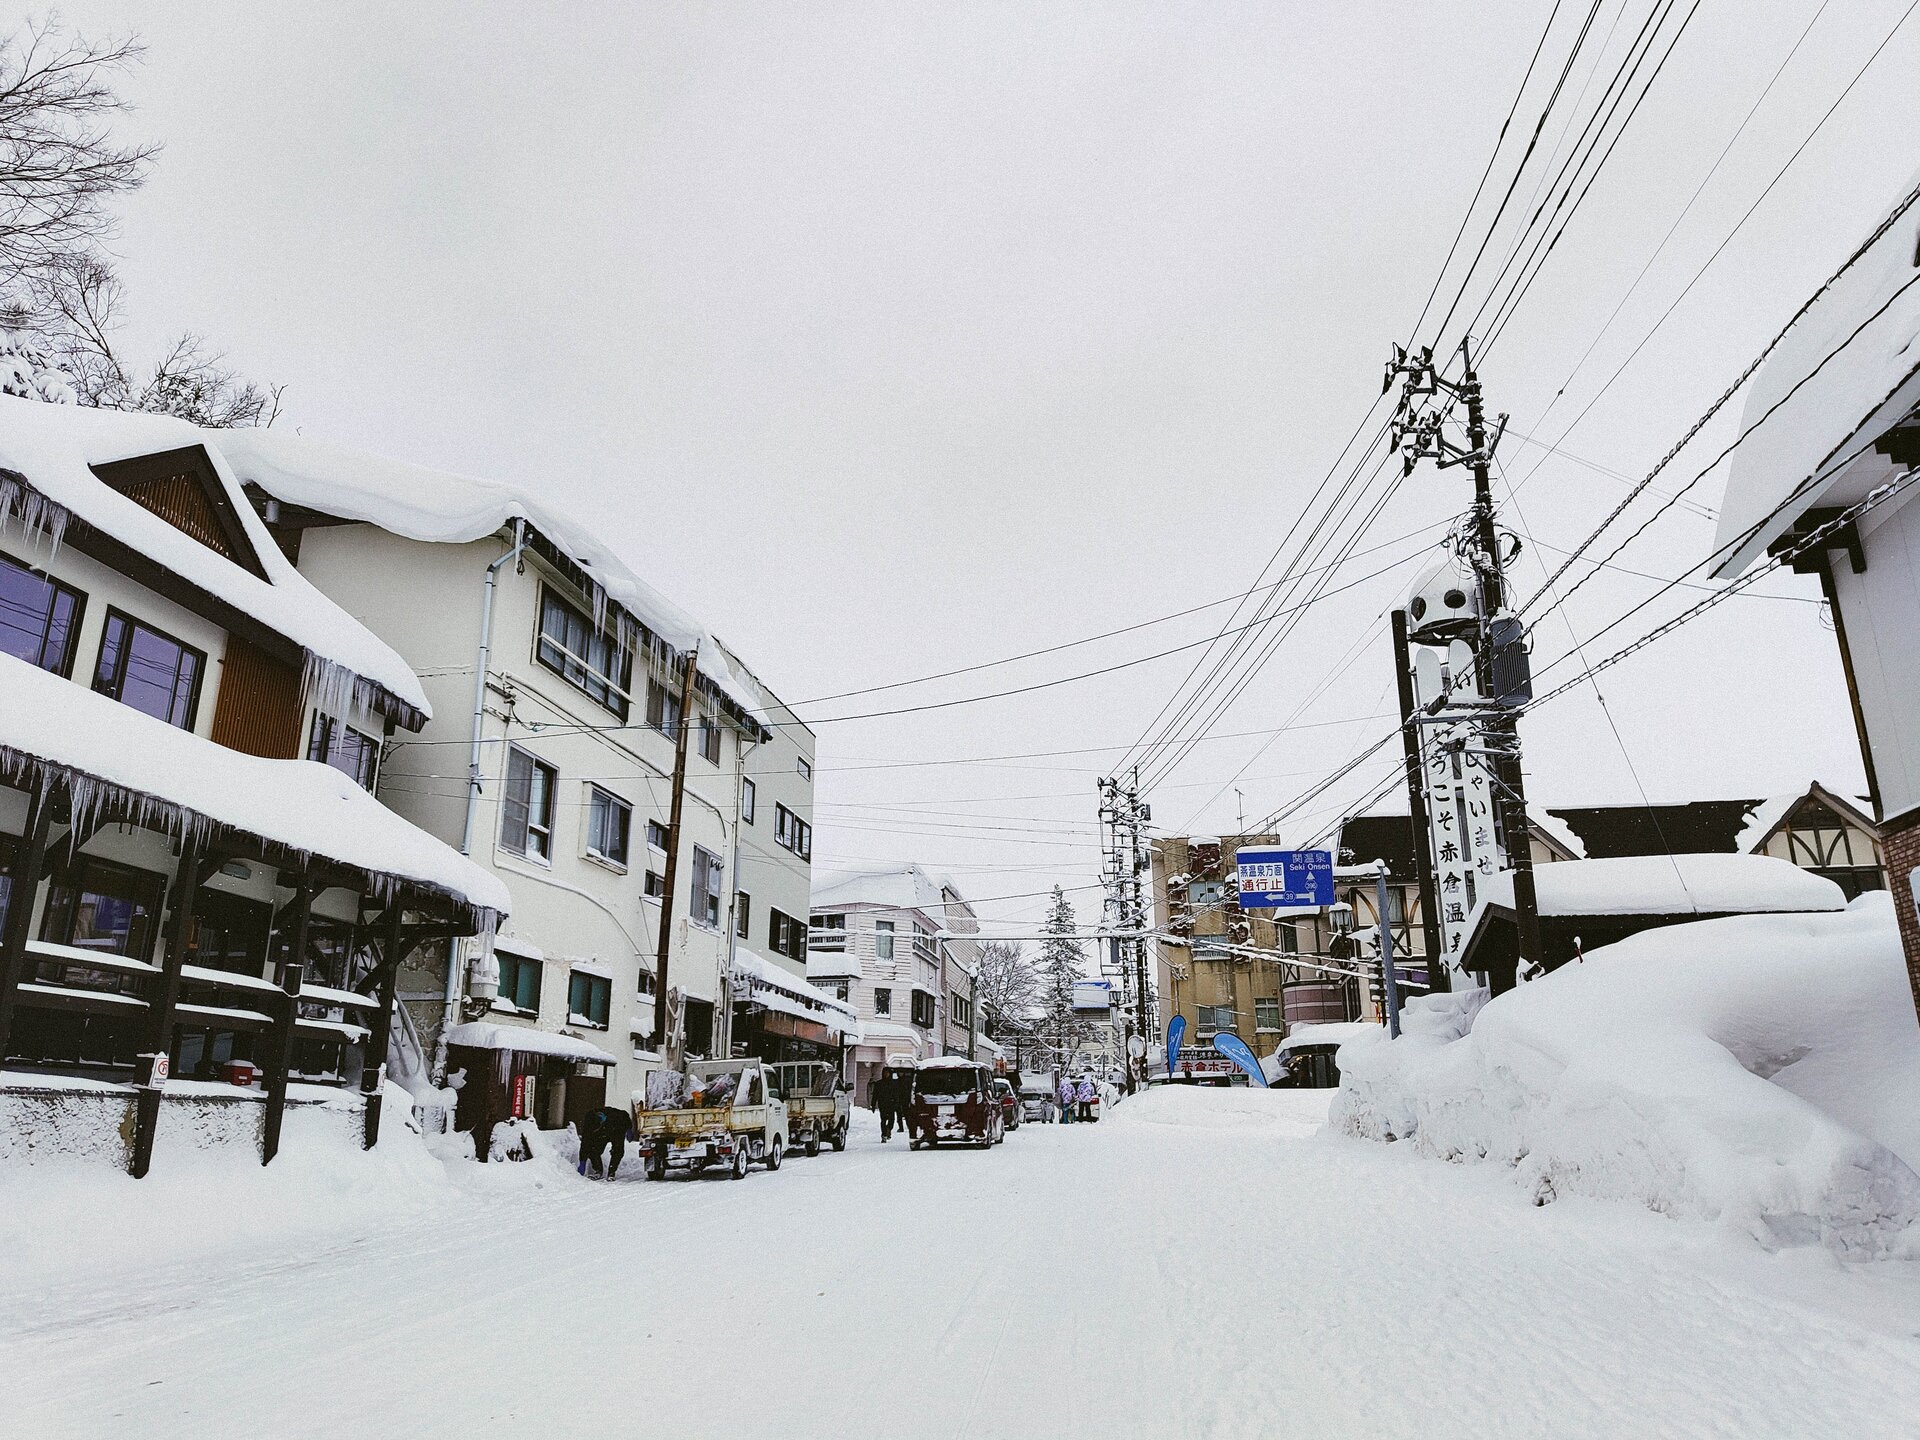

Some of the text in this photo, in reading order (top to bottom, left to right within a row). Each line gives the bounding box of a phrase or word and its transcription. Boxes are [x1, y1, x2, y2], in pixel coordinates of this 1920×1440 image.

[1453, 672, 1494, 876] いっしゃいませ
[1292, 853, 1327, 864] 関温泉
[1240, 864, 1282, 878] 燕温泉方面
[1289, 863, 1305, 871] Seki
[1241, 879, 1284, 892] 通行止
